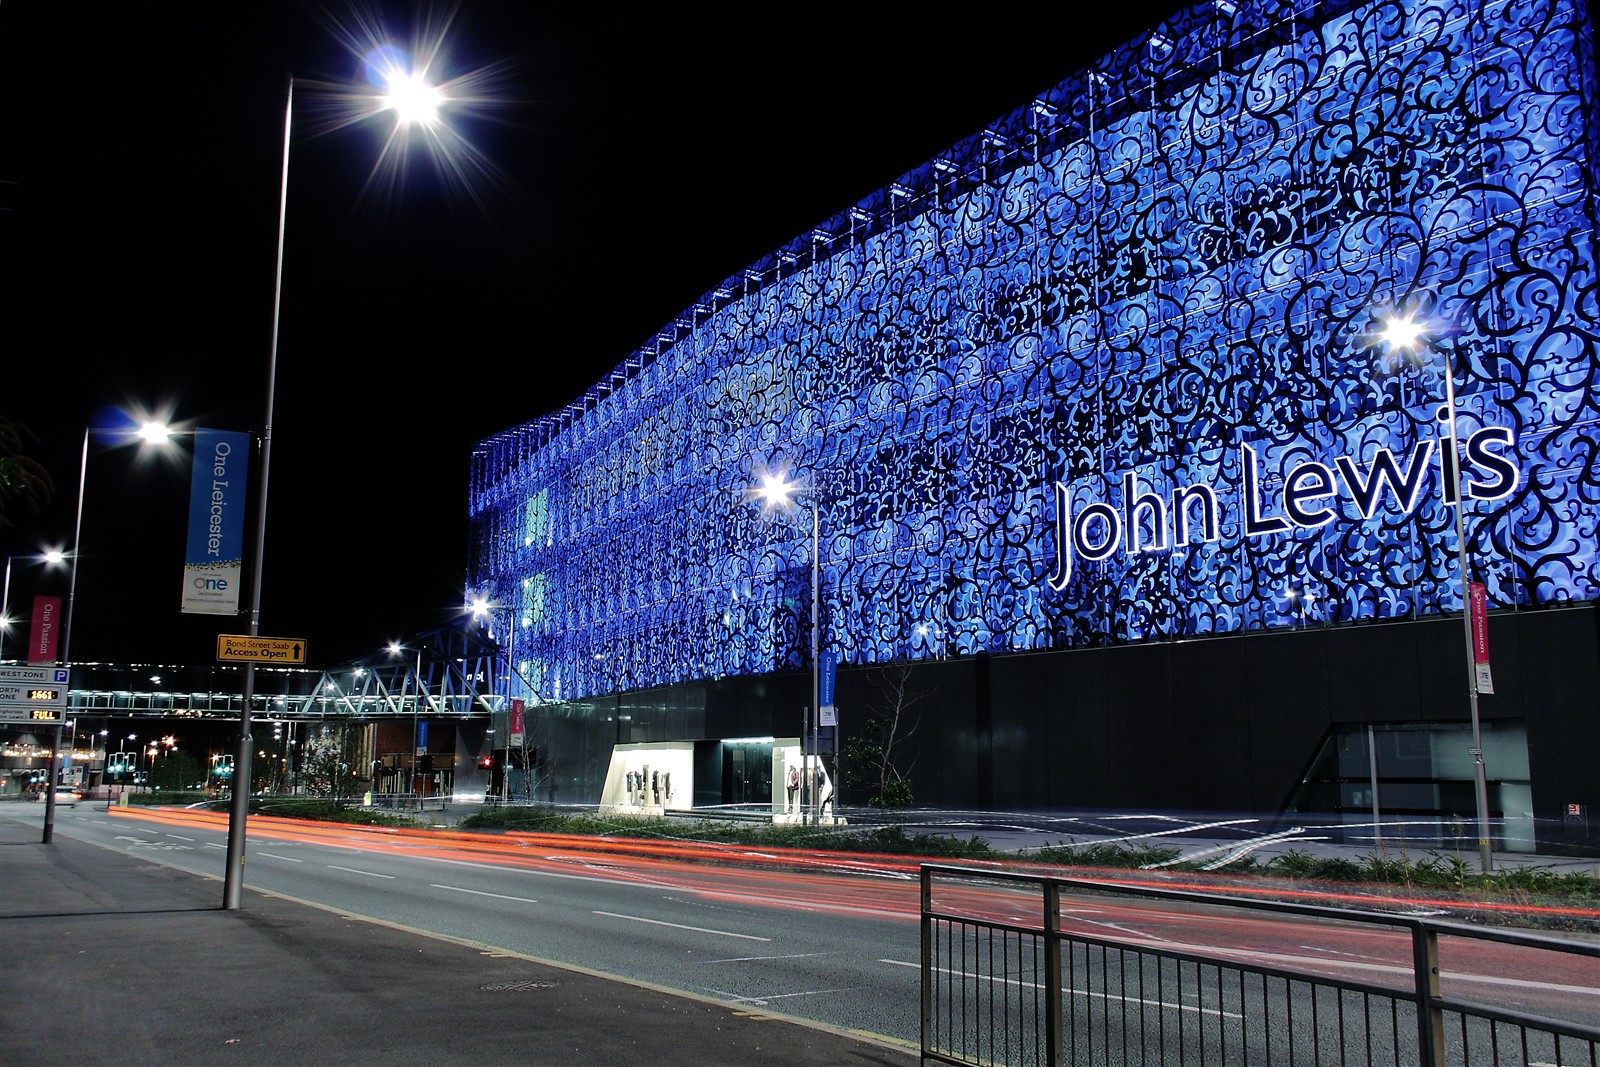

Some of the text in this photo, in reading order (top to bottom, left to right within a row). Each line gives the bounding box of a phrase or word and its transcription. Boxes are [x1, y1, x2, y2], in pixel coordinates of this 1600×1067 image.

[214, 442, 231, 476] One
[1049, 405, 1519, 590] John Lewis
[208, 479, 229, 557] Leicester
[194, 577, 228, 591] One
[1474, 593, 1482, 613] One
[40, 604, 53, 654] One Passion
[224, 647, 287, 659] Access Open
[226, 639, 290, 650] Bond Street Saab
[31, 690, 53, 700] 1661
[33, 711, 55, 720] FULL
